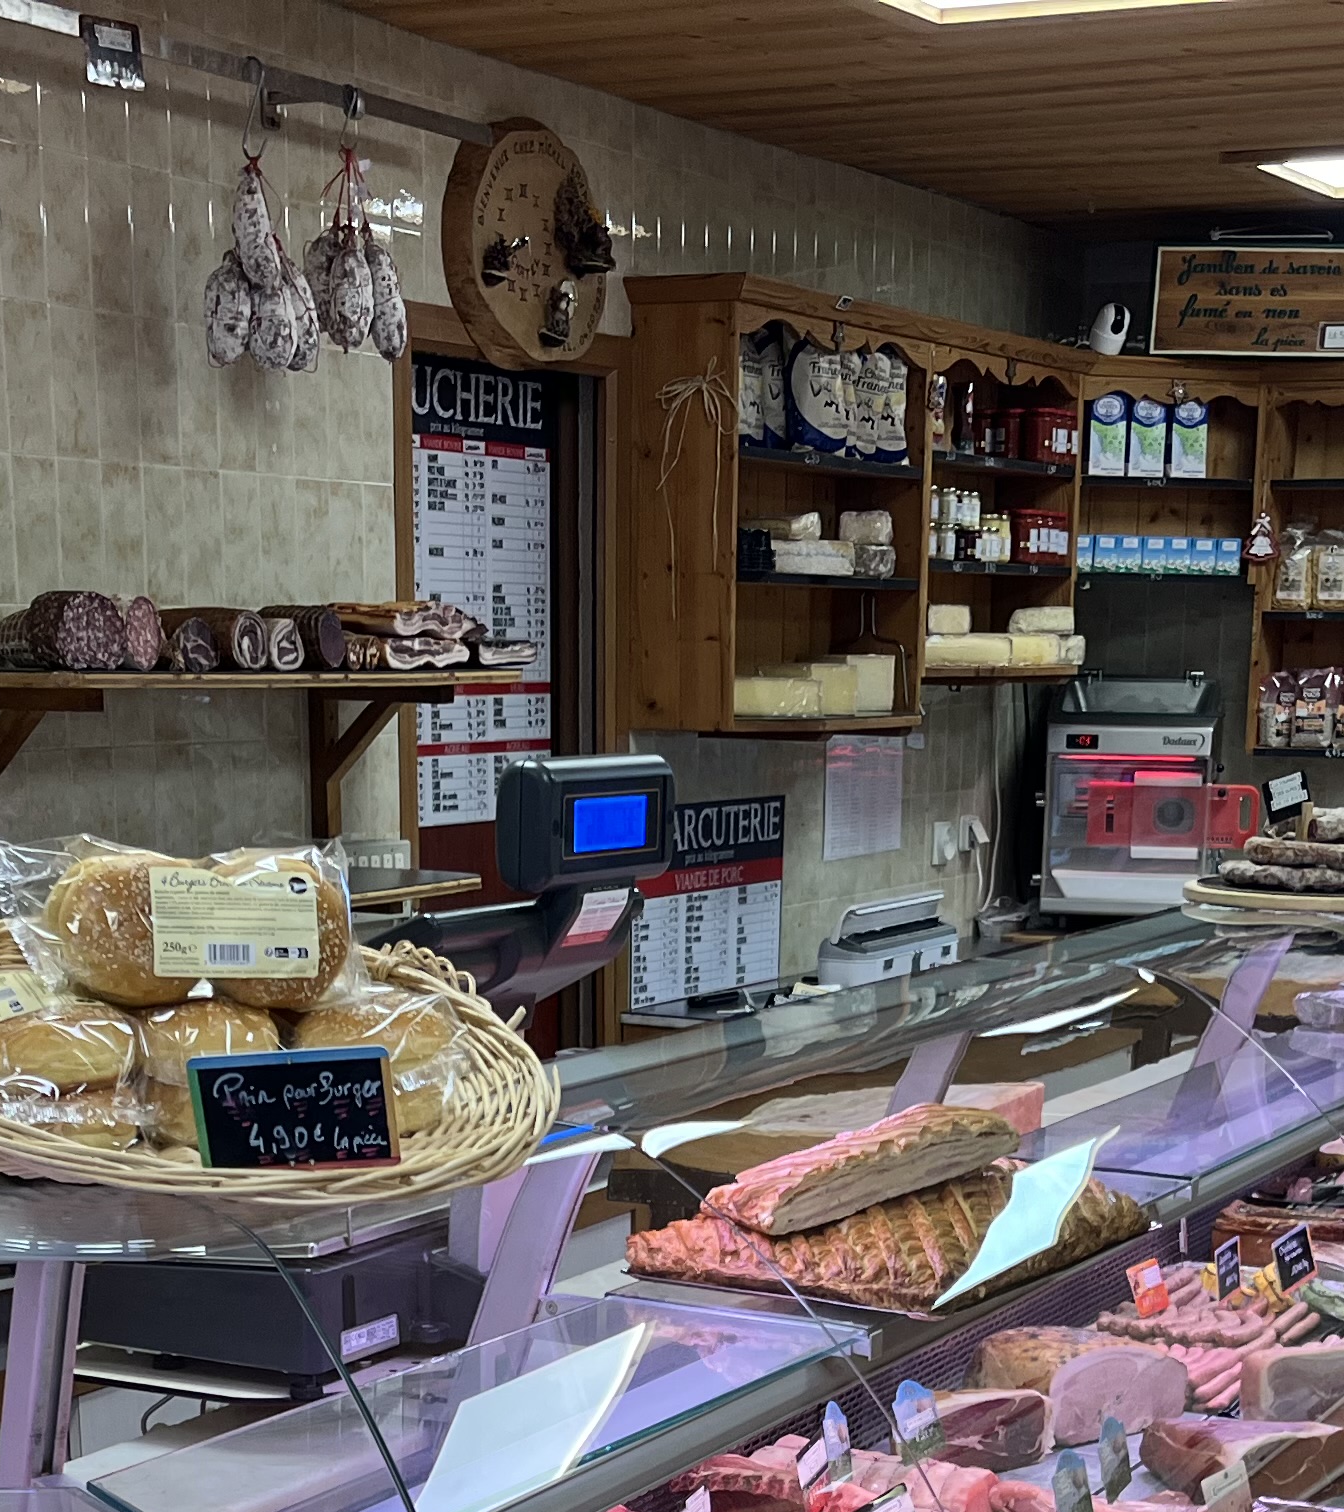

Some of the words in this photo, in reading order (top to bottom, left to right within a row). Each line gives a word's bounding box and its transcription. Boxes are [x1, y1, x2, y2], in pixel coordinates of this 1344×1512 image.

[412, 364, 542, 430] UCHERIE
[673, 802, 781, 852] ARCUTERIE
[675, 868, 707, 891] VIANDE
[708, 868, 720, 886] DE
[721, 865, 744, 885] PORC
[162, 942, 187, 954] 250g
[318, 1071, 381, 1108] Burger
